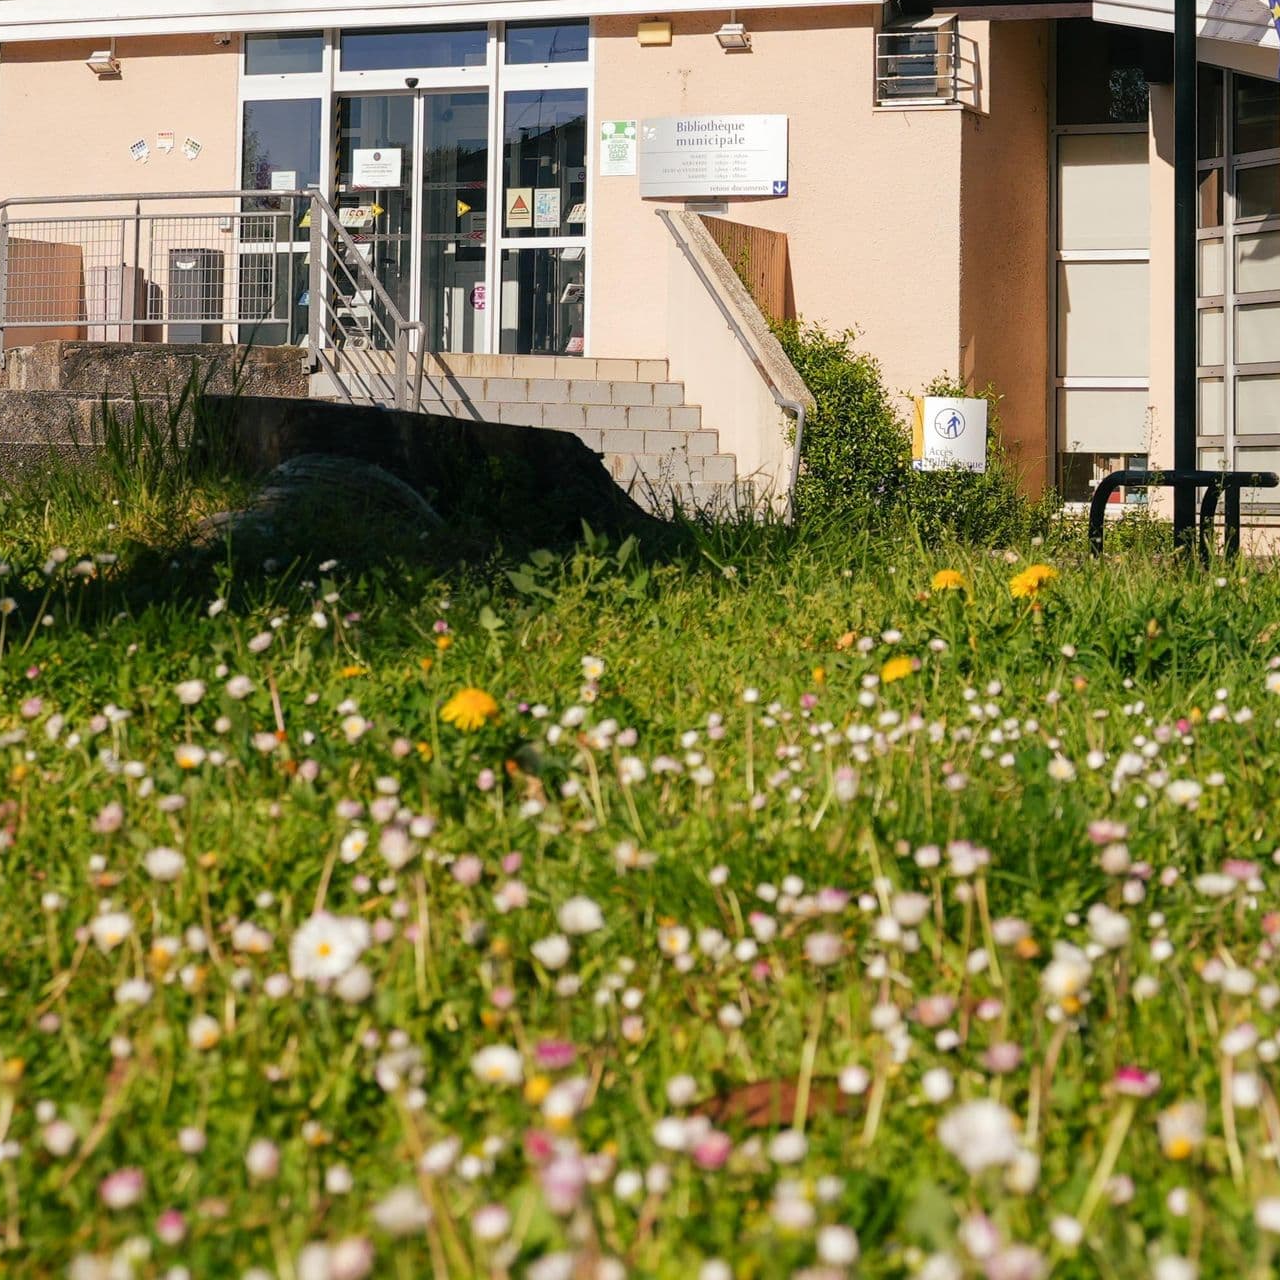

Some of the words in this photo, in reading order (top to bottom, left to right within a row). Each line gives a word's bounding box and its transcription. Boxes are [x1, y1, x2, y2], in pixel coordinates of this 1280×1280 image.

[676, 120, 745, 134] Bibliothèque
[676, 133, 745, 148] municipale
[731, 183, 769, 192] documents
[929, 445, 953, 456] Accès
